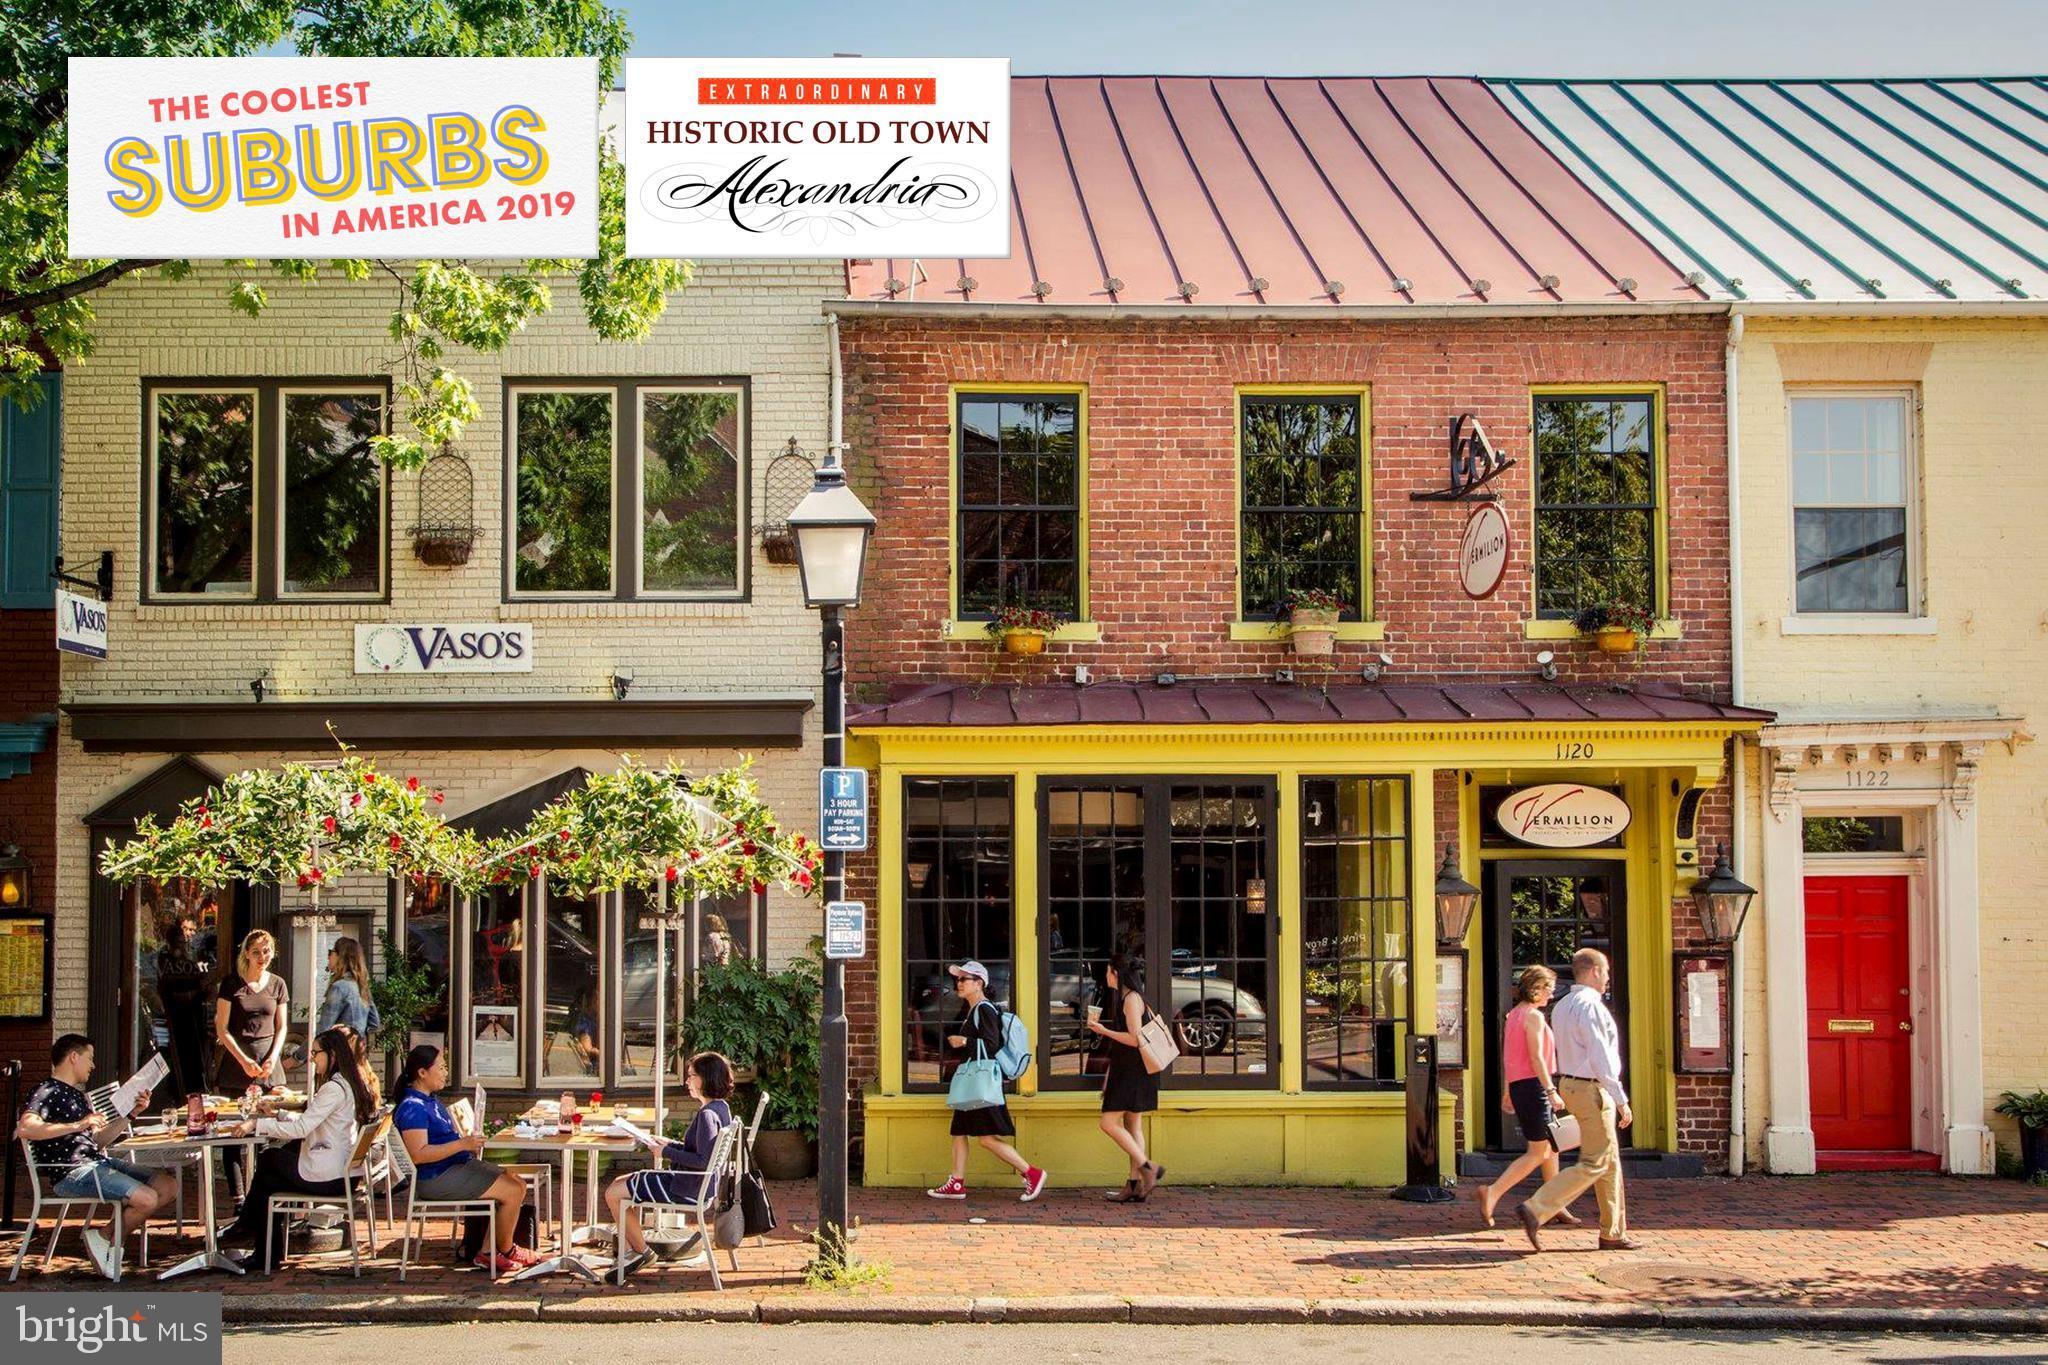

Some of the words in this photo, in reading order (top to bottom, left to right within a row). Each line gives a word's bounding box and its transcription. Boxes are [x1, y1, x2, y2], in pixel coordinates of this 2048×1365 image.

[72, 600, 106, 634] VASO'S
[404, 627, 523, 670] VASO'S
[1556, 743, 1594, 761] 1120
[837, 775, 851, 797] P
[1846, 771, 1889, 788] 1122
[824, 809, 837, 817] PAY
[838, 809, 864, 817] PARKING
[830, 799, 835, 808] 3
[837, 799, 857, 808] HOUR
[1513, 789, 1613, 836] VERMILION
